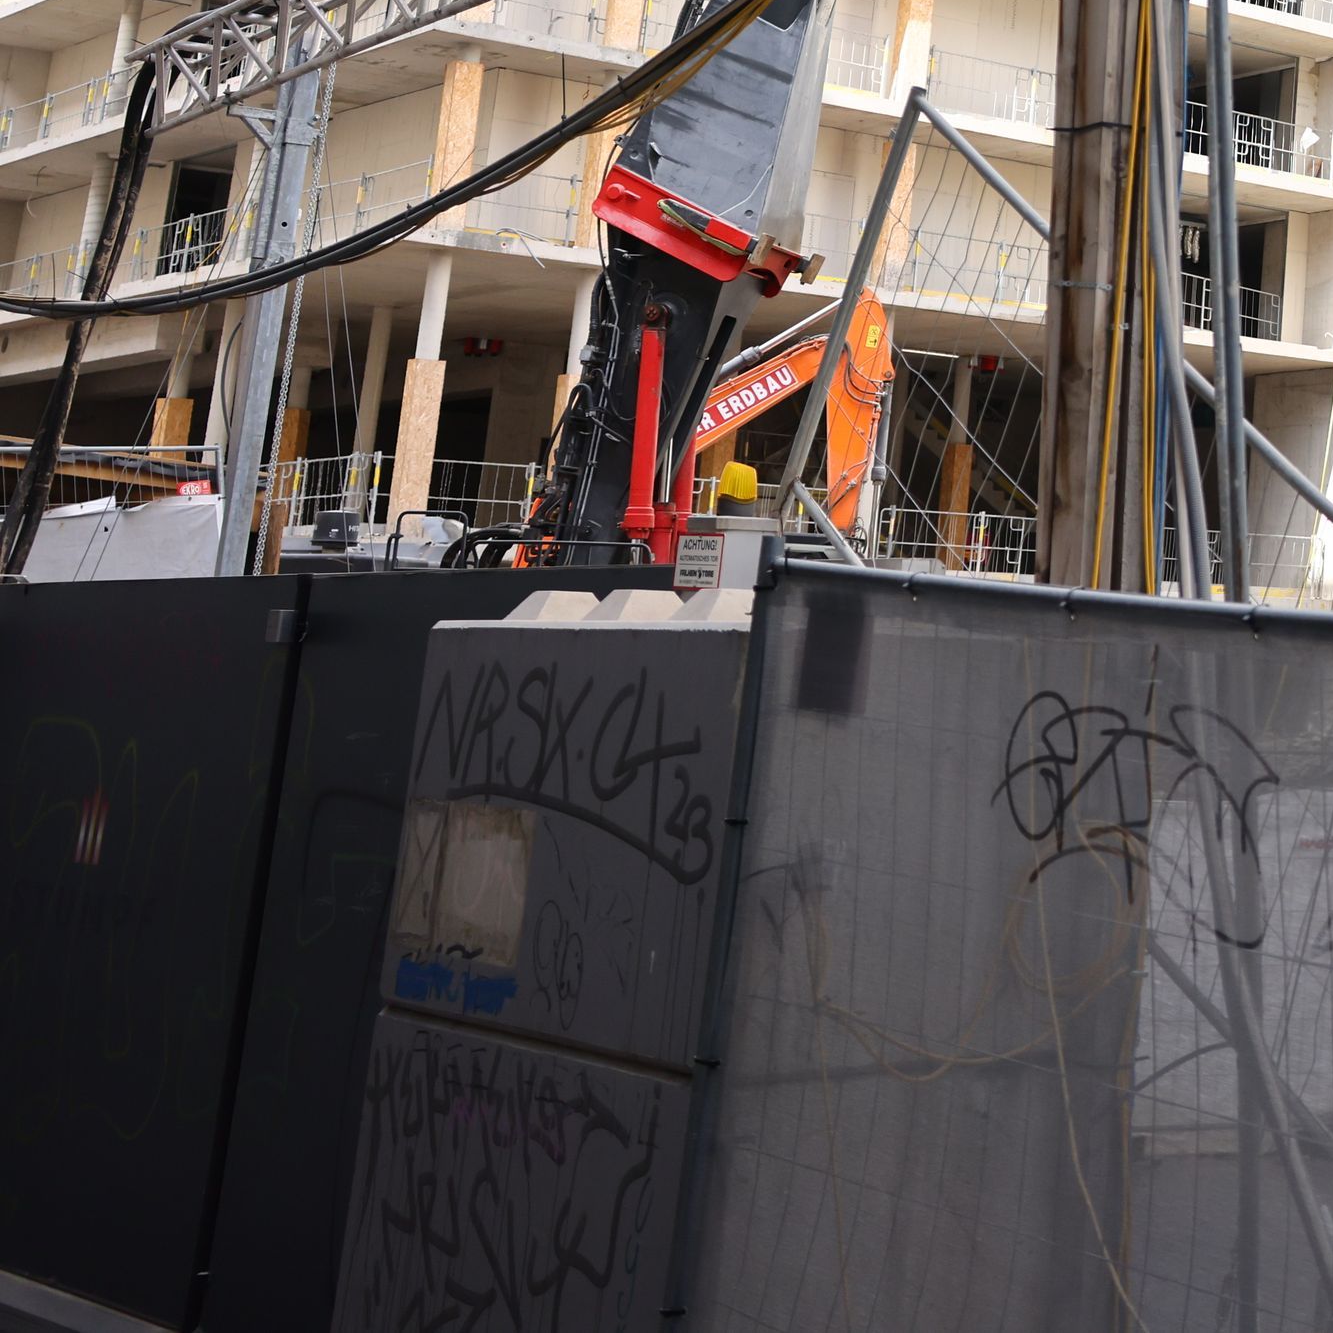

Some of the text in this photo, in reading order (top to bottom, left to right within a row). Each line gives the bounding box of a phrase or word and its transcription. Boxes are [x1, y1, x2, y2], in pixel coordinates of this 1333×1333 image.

[716, 367, 792, 420] ERDBAU
[183, 484, 200, 495] EKRO
[683, 539, 718, 551] ACHTUNG!
